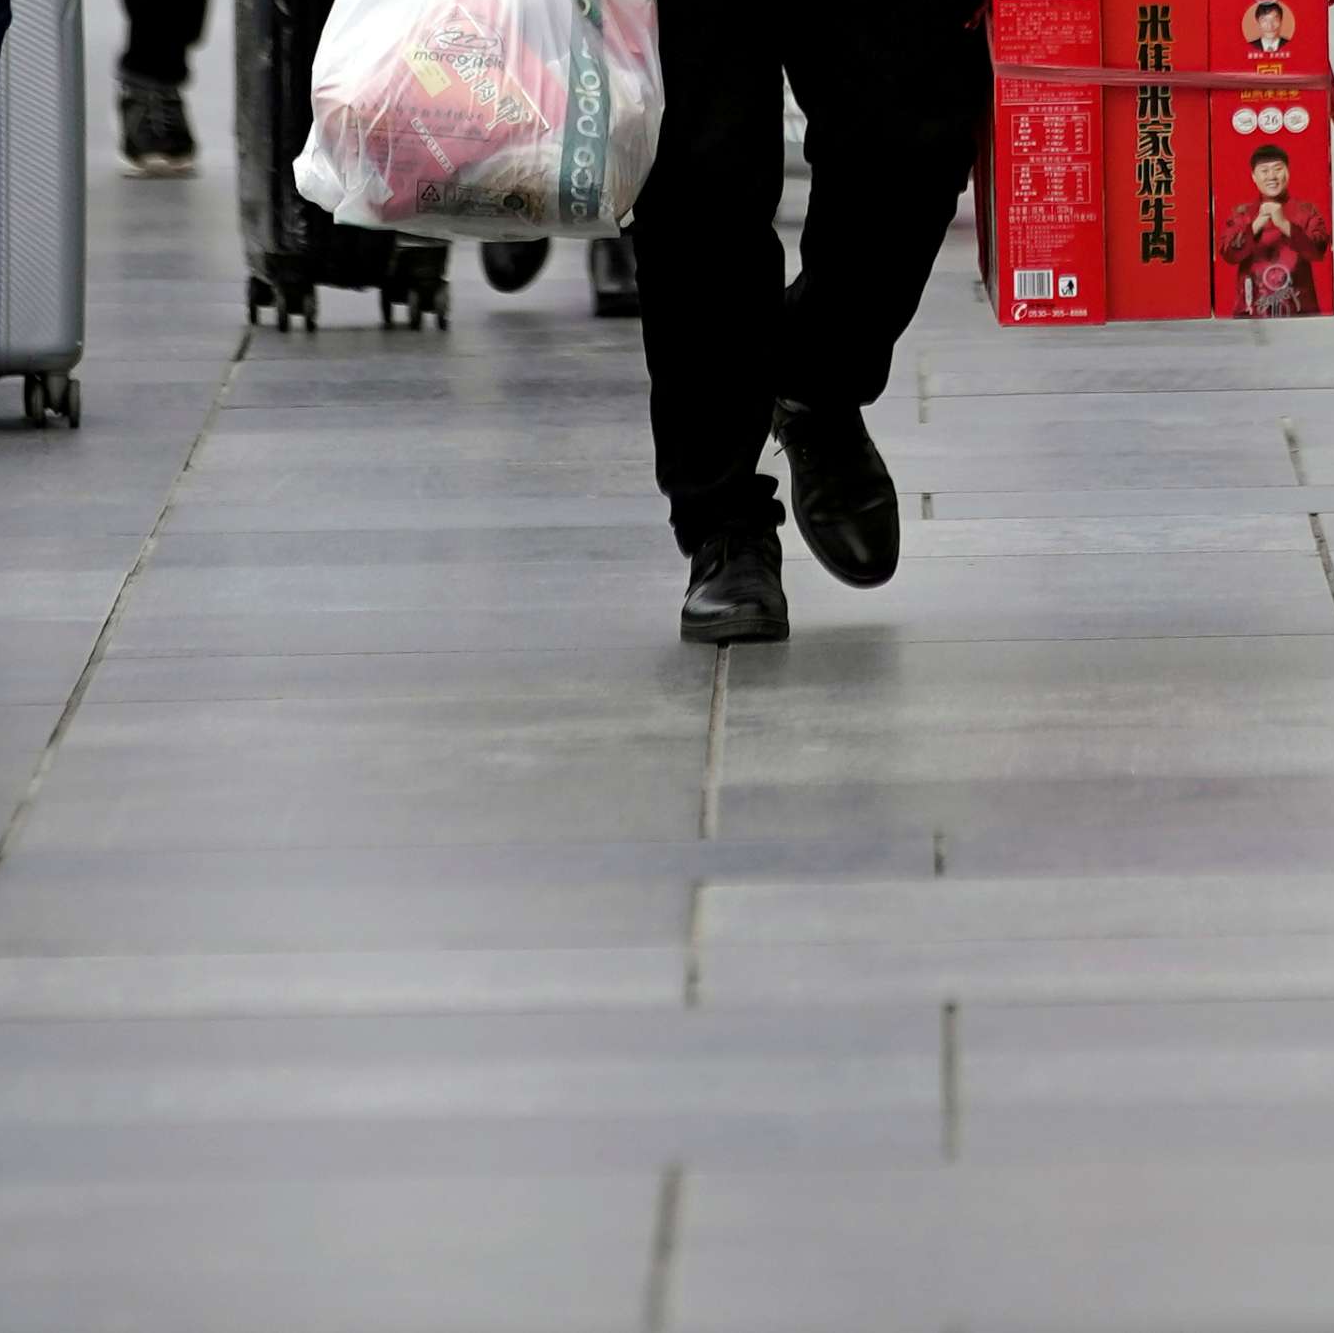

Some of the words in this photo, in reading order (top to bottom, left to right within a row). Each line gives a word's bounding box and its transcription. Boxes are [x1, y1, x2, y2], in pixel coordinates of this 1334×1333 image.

[1136, 3, 1176, 264] 米伟米家烧牛肉
